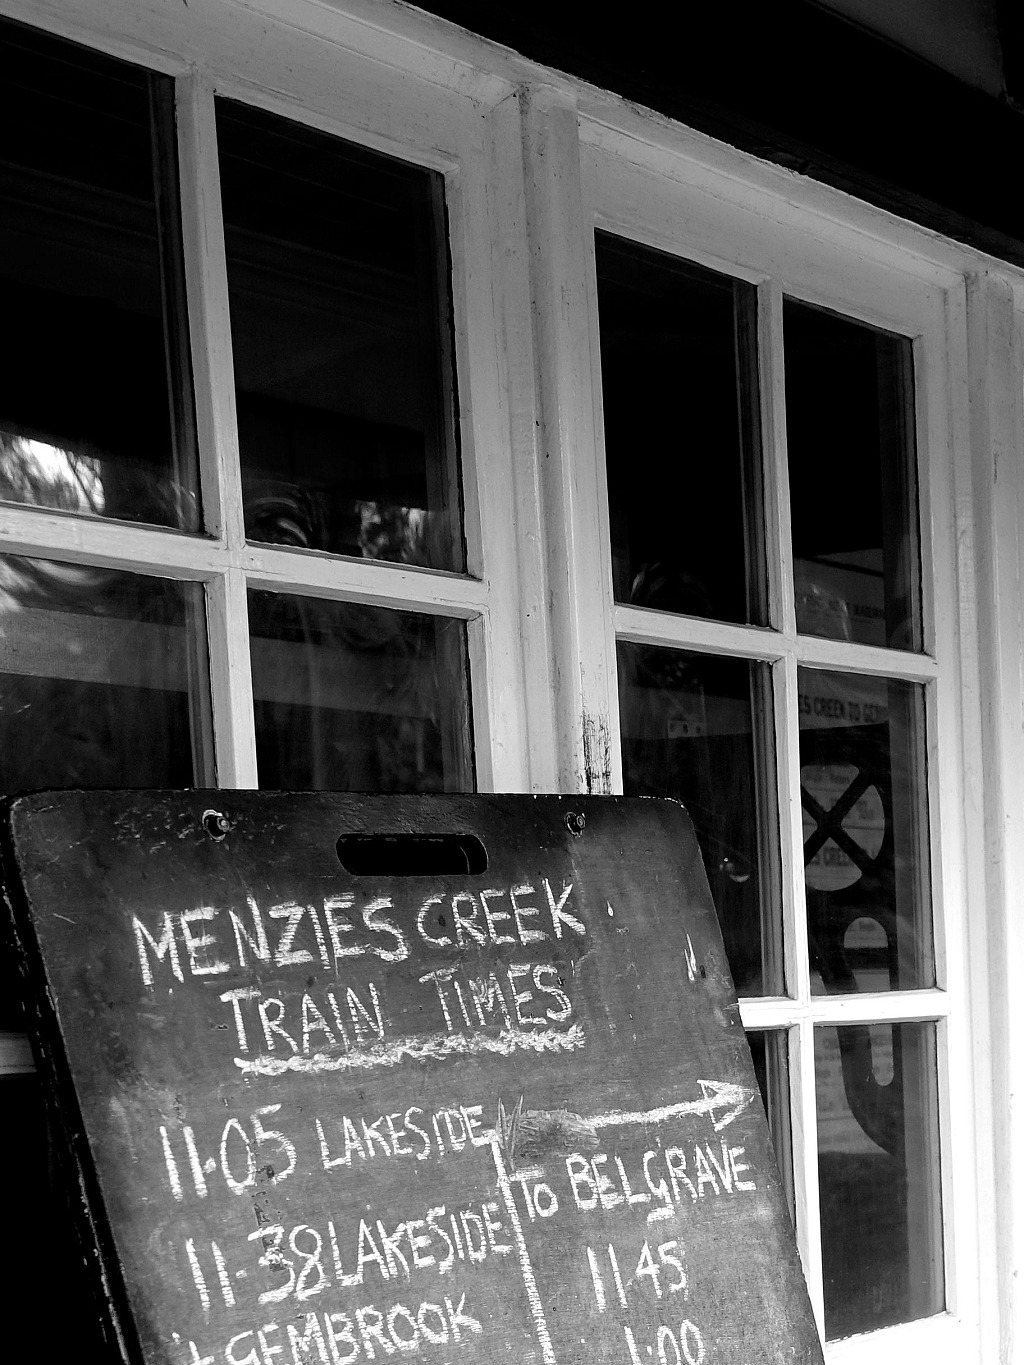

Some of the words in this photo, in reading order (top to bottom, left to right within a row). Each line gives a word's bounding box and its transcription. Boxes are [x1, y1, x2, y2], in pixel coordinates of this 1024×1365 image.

[131, 891, 409, 986] MENZIES
[416, 878, 586, 949] CREEK
[219, 982, 386, 1054] TRAIN
[419, 963, 573, 1031] TIMES
[315, 1105, 487, 1171] LAKESIDE
[510, 1165, 560, 1222] TO
[566, 1143, 758, 1224] BELGRAVE
[328, 1203, 513, 1286] LAKESIDE
